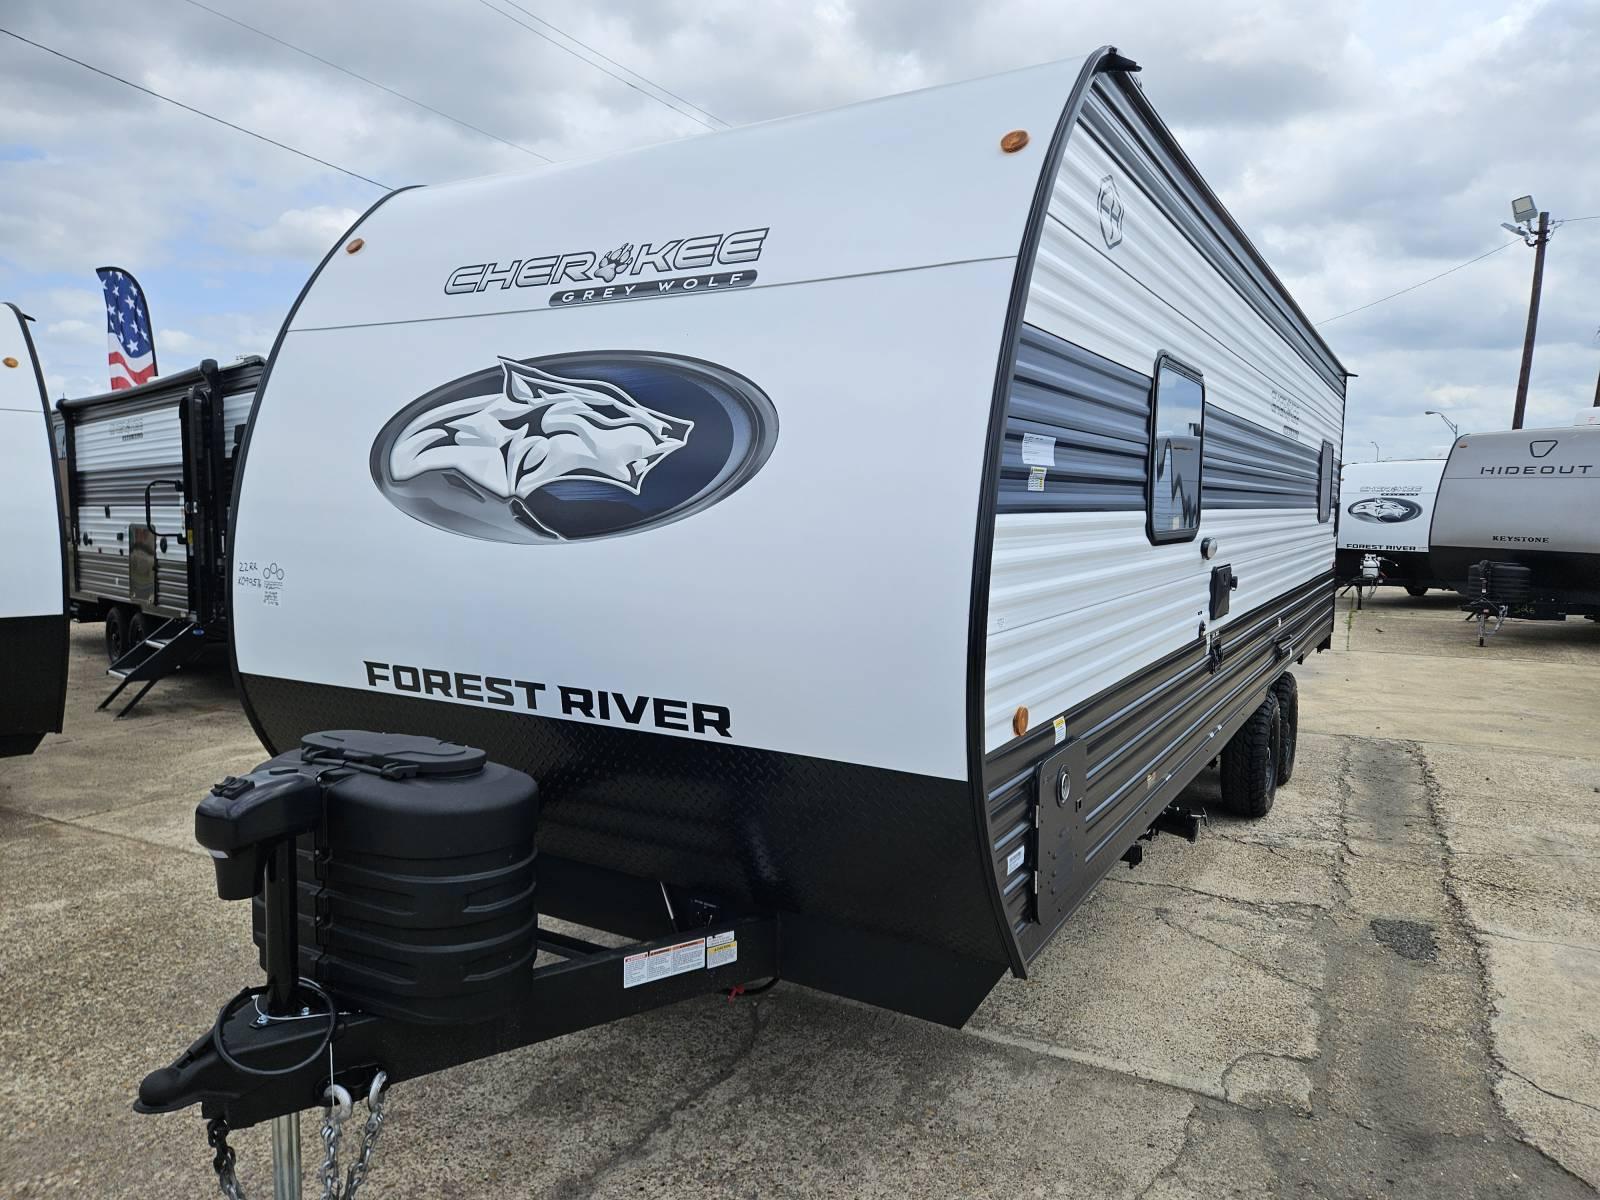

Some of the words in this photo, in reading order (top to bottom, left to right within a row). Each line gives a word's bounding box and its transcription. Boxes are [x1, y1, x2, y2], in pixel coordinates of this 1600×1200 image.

[561, 285, 636, 303] GREY
[658, 272, 745, 291] WOLF
[1480, 465, 1593, 475] HIDEOUT
[1492, 535, 1550, 544] KEYSTONE
[363, 660, 546, 710] FOREST
[557, 685, 733, 738] RIVER
